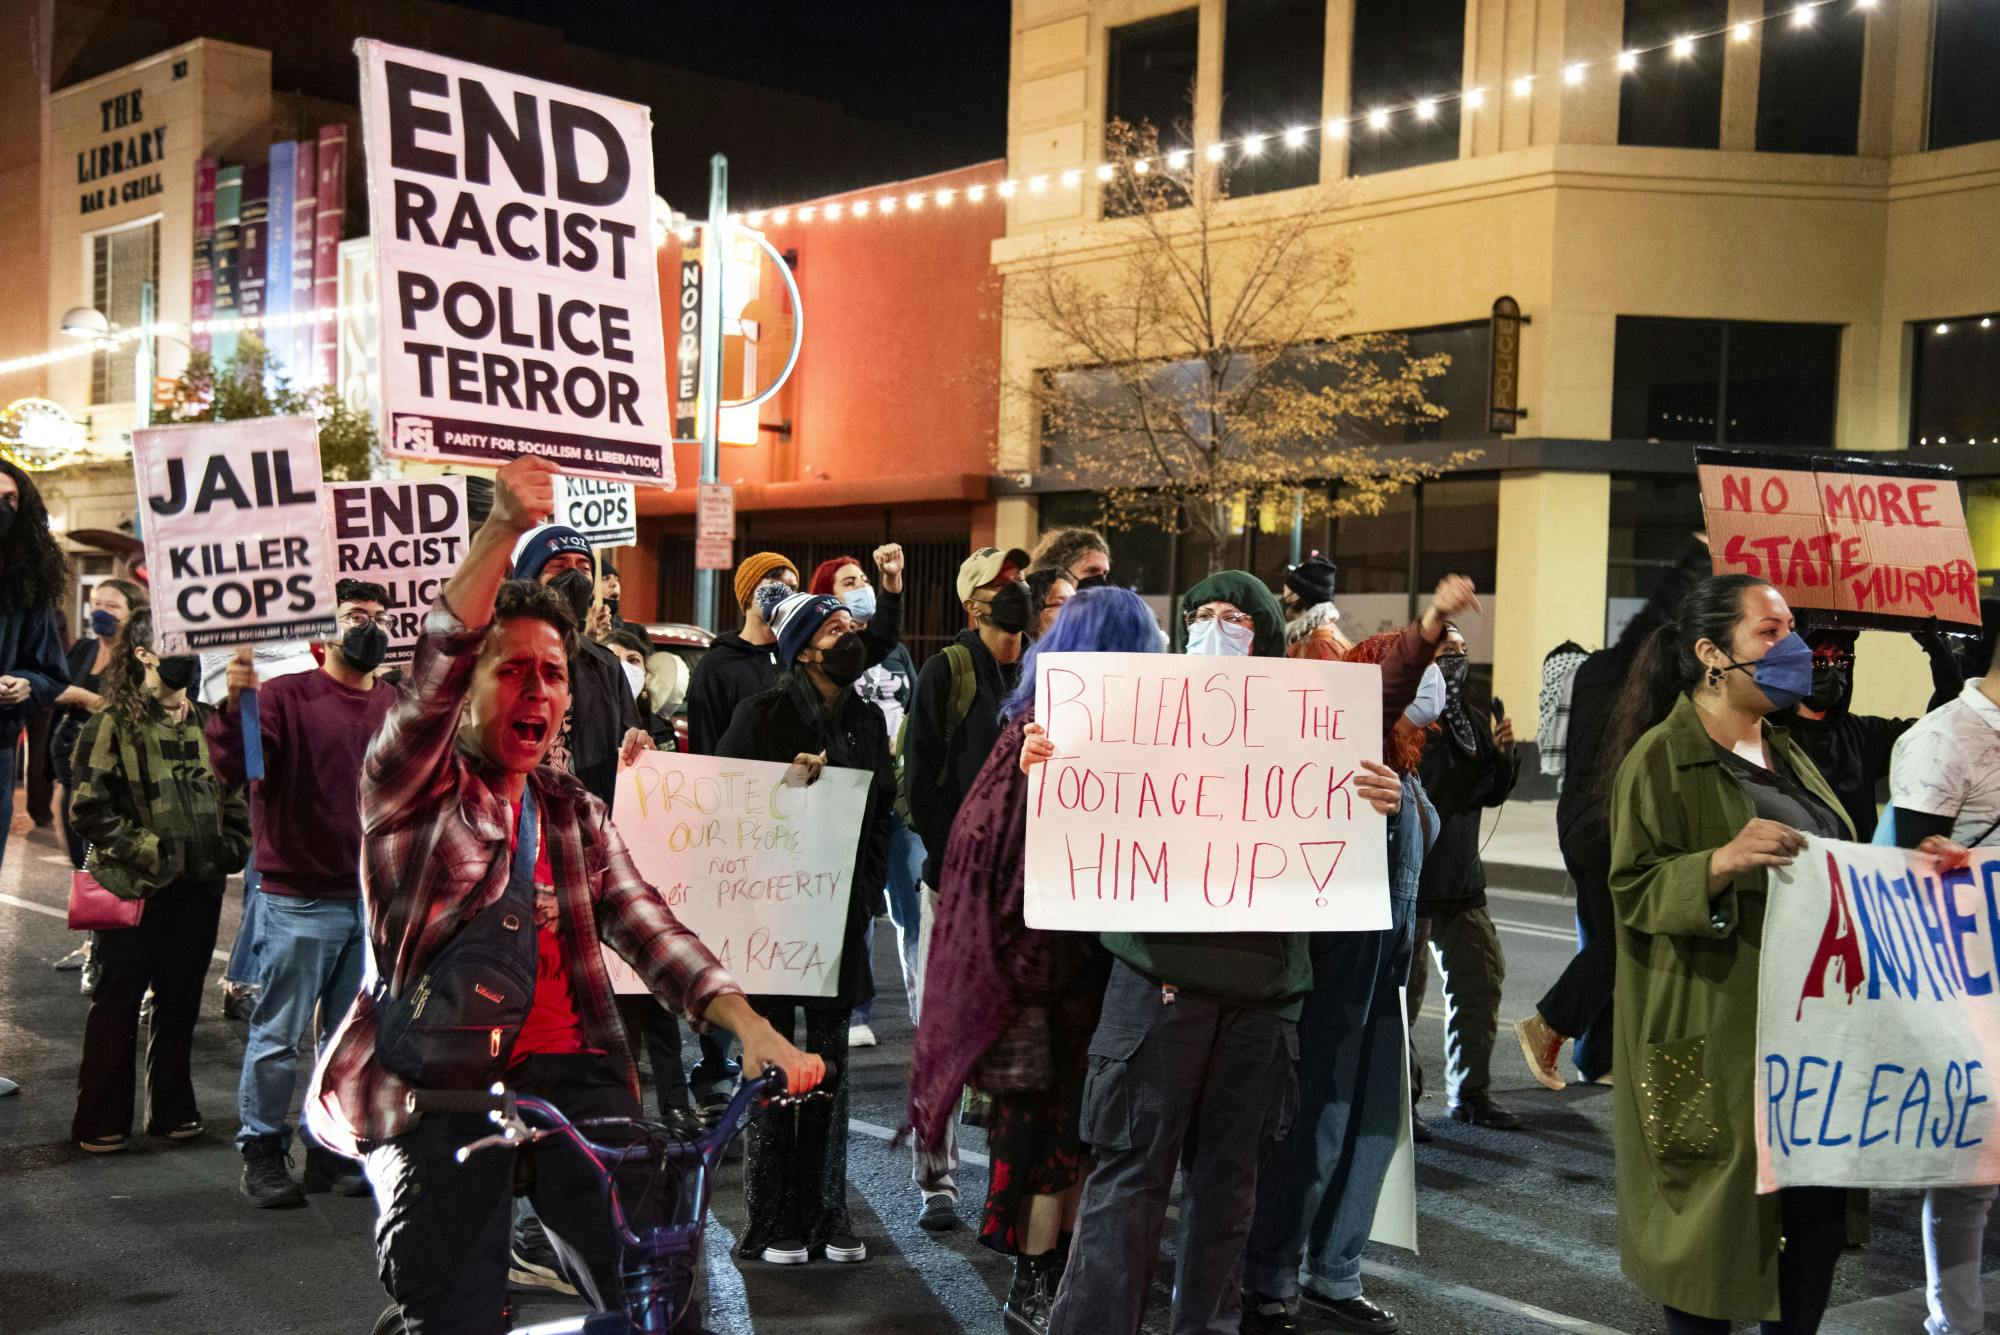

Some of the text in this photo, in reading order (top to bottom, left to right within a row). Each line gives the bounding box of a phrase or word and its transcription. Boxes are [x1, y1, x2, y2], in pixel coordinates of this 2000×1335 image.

[101, 88, 142, 132] THE
[385, 60, 631, 207] END
[77, 126, 166, 184] LIBRARY
[80, 190, 104, 214] BAR
[122, 173, 163, 202] GRILL
[393, 179, 636, 280] RACIST
[398, 270, 634, 364] POLICE
[679, 264, 699, 399] NOODLE
[403, 341, 643, 427] TERROR
[1494, 319, 1513, 408] POLICE
[445, 431, 660, 469] PARTY FOR SOCIALISM & LIBERATION
[148, 449, 317, 516] JAIL
[1722, 474, 1941, 528] NO MORE
[333, 483, 459, 540] END
[568, 497, 628, 528] COPS
[169, 536, 311, 580] KILLER
[338, 536, 461, 572] RACIST
[1724, 532, 1870, 588] STATE
[176, 574, 317, 624] COPS
[1852, 559, 1979, 617] MURDER
[193, 633, 220, 646] PARTY
[221, 630, 238, 642] FOR
[239, 626, 281, 641] SOCIALISM
[1047, 668, 1346, 748] RELEASE THE
[1242, 762, 1355, 822] LOCK
[668, 819, 726, 852] OUR
[662, 870, 842, 908] eir PROPERTY
[708, 856, 752, 875] NOT
[1065, 832, 1168, 903] HIM
[746, 927, 826, 980] RAZA
[1765, 1053, 1988, 1156] RELEASE
